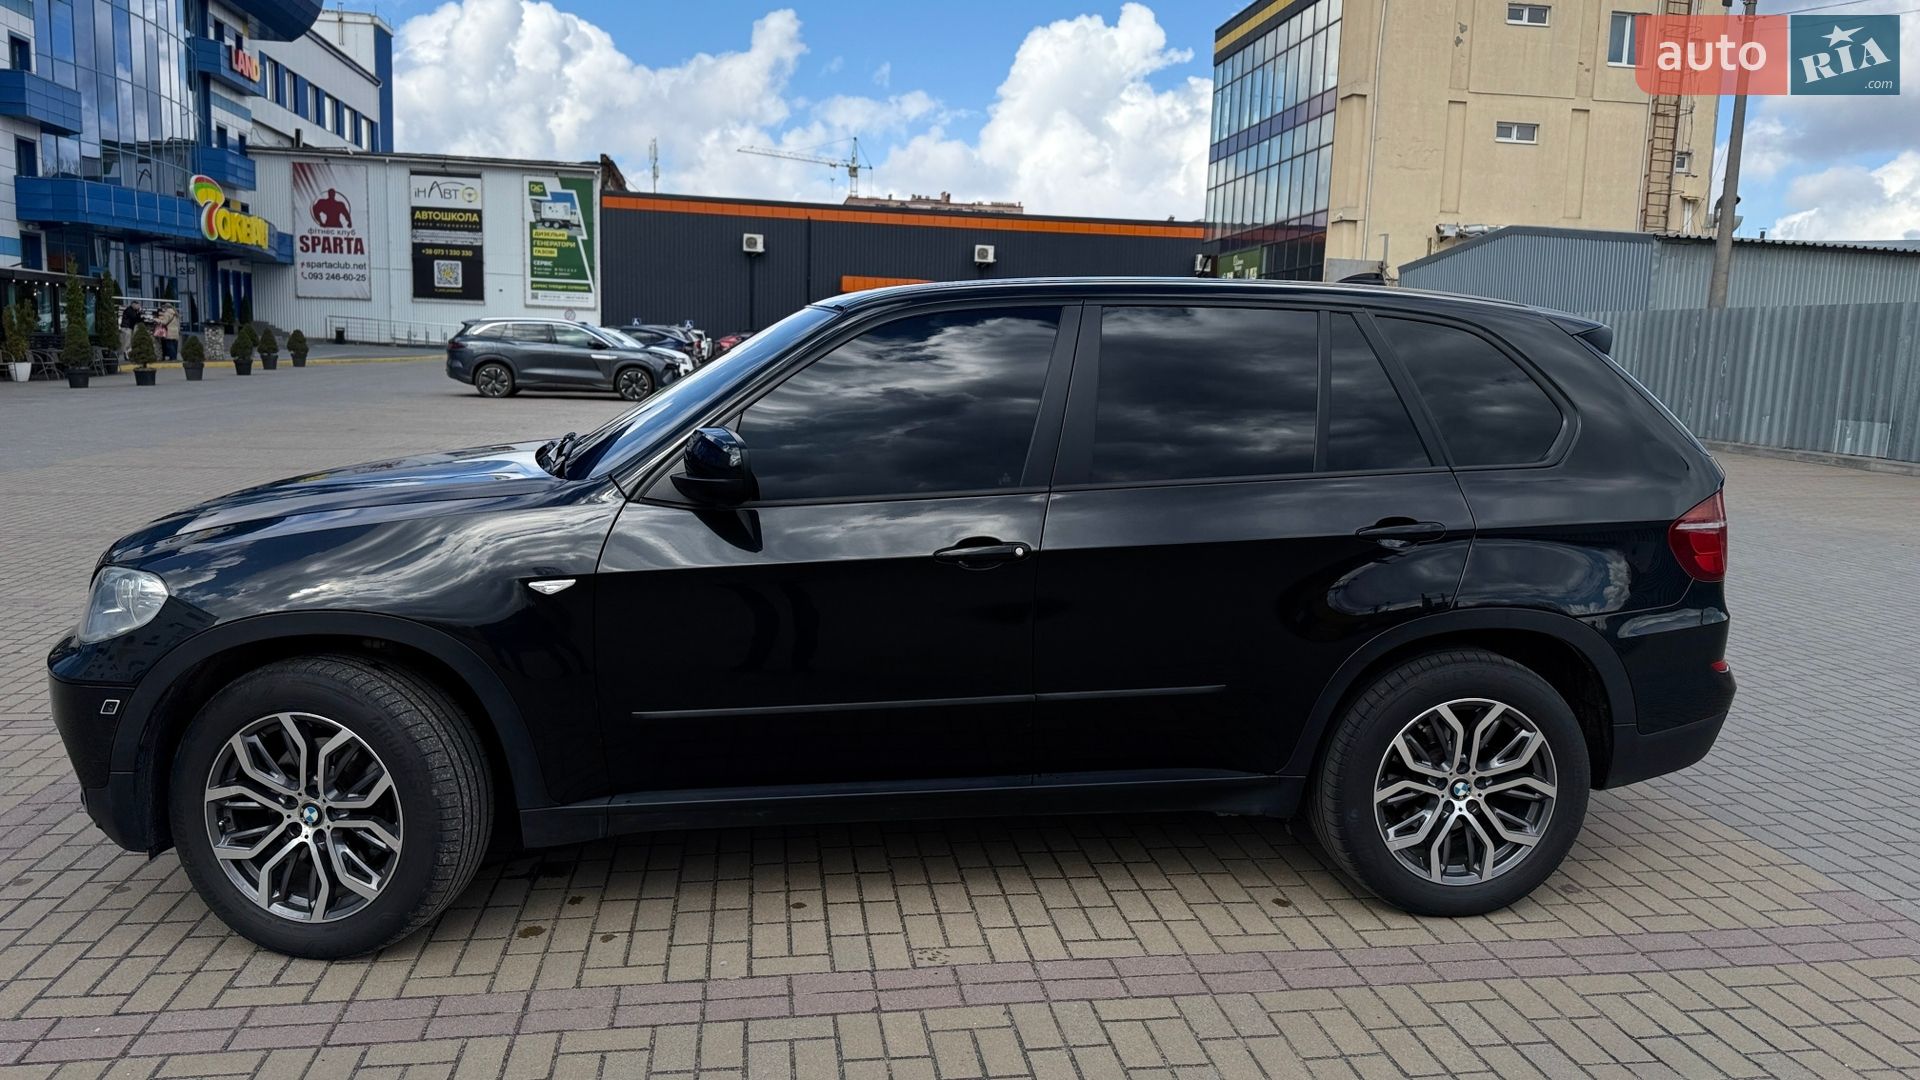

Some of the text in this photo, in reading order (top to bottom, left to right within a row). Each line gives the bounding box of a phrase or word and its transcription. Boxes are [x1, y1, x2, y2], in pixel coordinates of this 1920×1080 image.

[231, 48, 260, 82] LAND
[414, 210, 480, 222] АВТОШКОЛА
[299, 235, 365, 255] SPARTA
[533, 240, 576, 248] ГЕНЕРАТОРИ
[306, 261, 367, 270] spartaclub.net
[308, 272, 323, 280] 093
